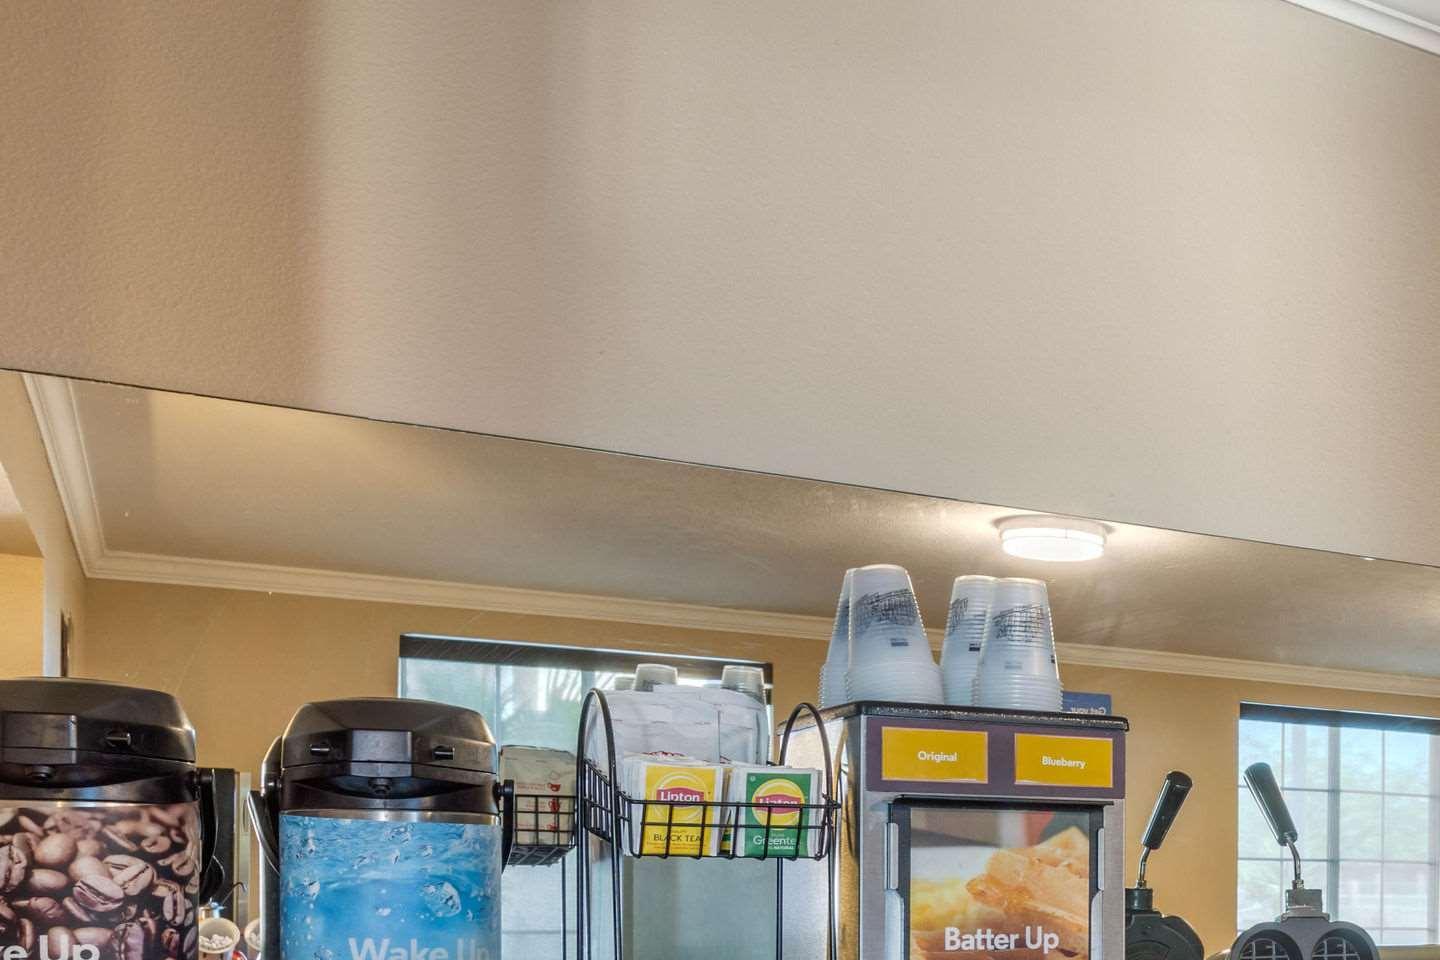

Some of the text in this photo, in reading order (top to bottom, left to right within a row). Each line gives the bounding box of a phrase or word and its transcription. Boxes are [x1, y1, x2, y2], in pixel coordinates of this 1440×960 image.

[917, 750, 958, 763] Original
[1041, 755, 1087, 770] Blueberry
[943, 925, 1060, 954] Batter Up
